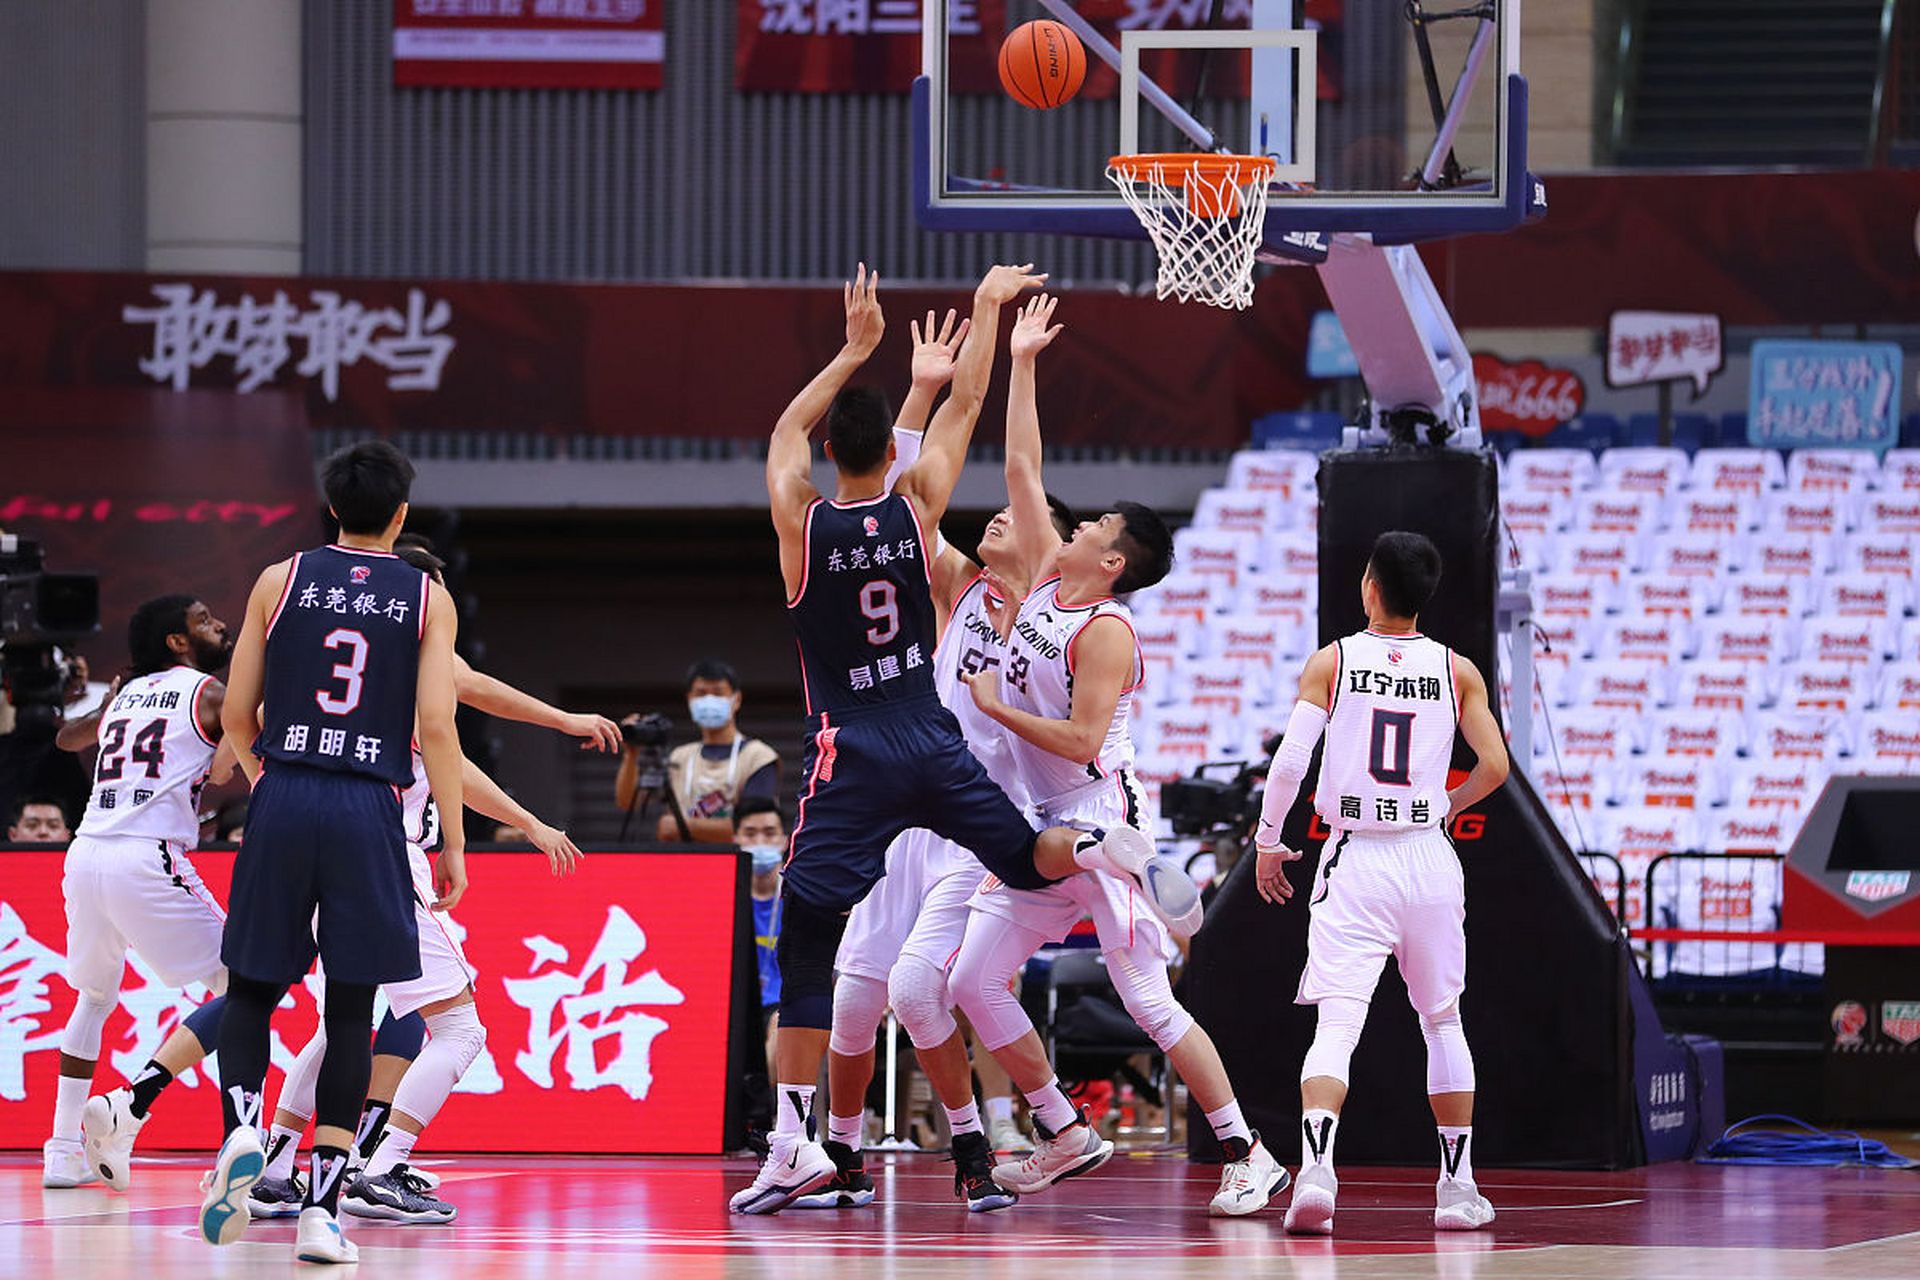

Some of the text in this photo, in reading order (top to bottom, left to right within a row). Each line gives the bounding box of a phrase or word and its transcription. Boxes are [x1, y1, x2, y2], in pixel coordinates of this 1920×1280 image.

[123, 283, 456, 402] 敢梦敢当
[827, 538, 916, 572] 东莞银行
[298, 582, 409, 624] 东莞银行
[859, 579, 901, 646] 9
[316, 627, 370, 715] 3
[849, 643, 924, 690] 易建联
[1349, 669, 1441, 701] 辽宁本钢
[97, 717, 169, 784] 24
[283, 724, 382, 764] 胡明轩
[1367, 707, 1417, 787] 0
[1339, 795, 1430, 824] 高诗岩
